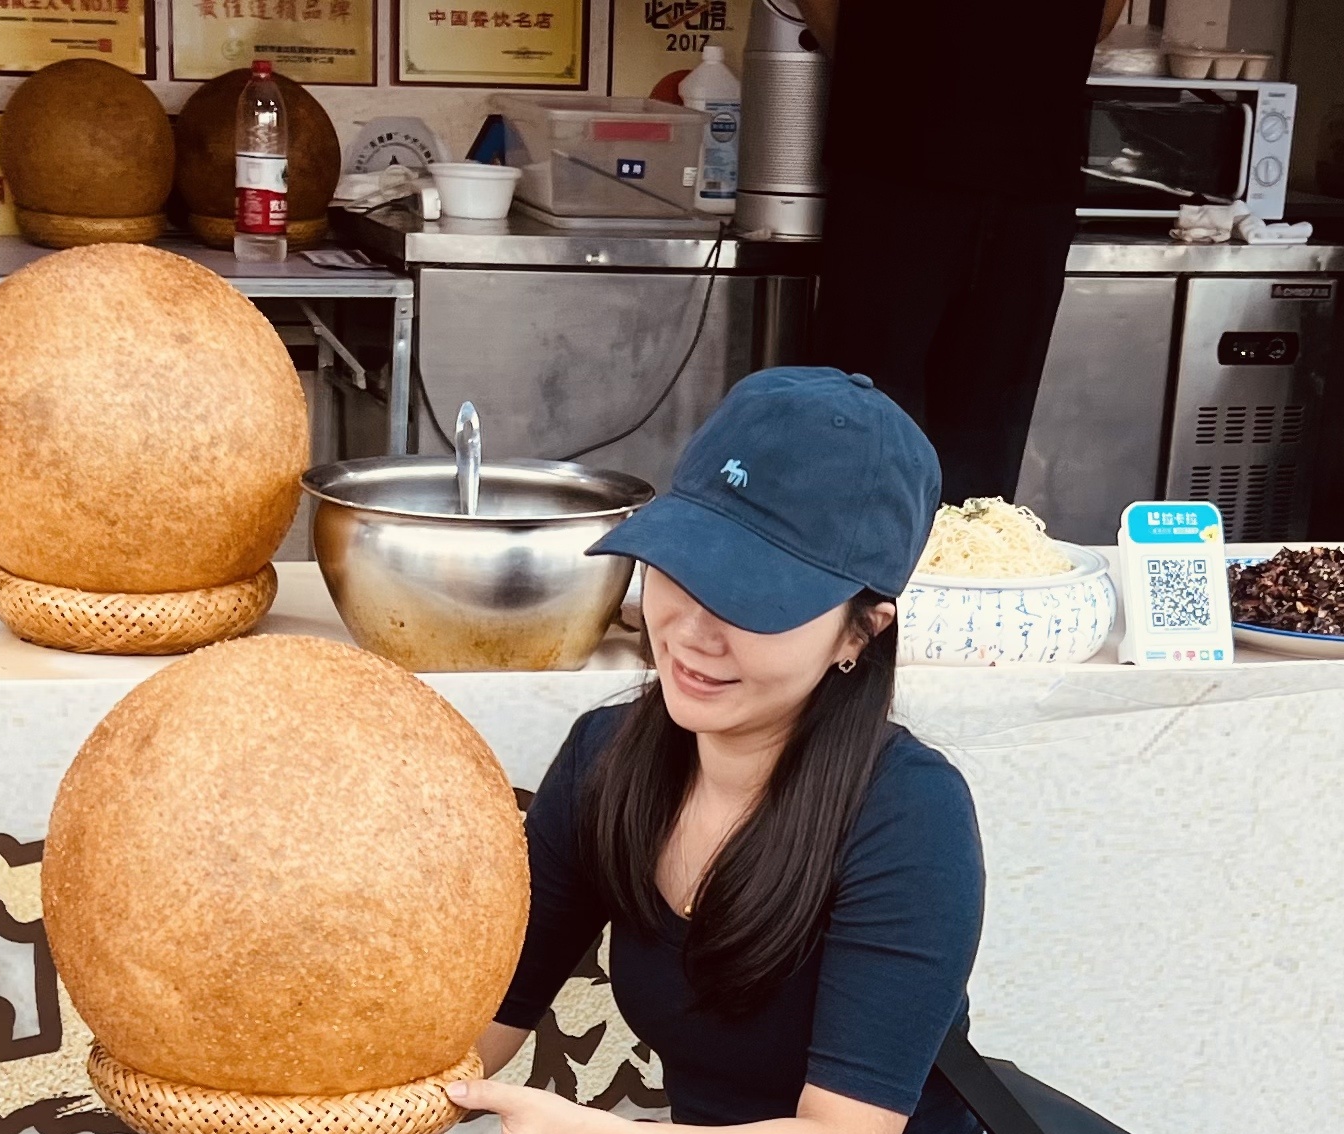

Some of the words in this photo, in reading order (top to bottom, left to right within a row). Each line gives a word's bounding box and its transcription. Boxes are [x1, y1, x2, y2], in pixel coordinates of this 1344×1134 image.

[428, 9, 554, 29] 中国餐饮名店
[666, 33, 710, 52] 2017
